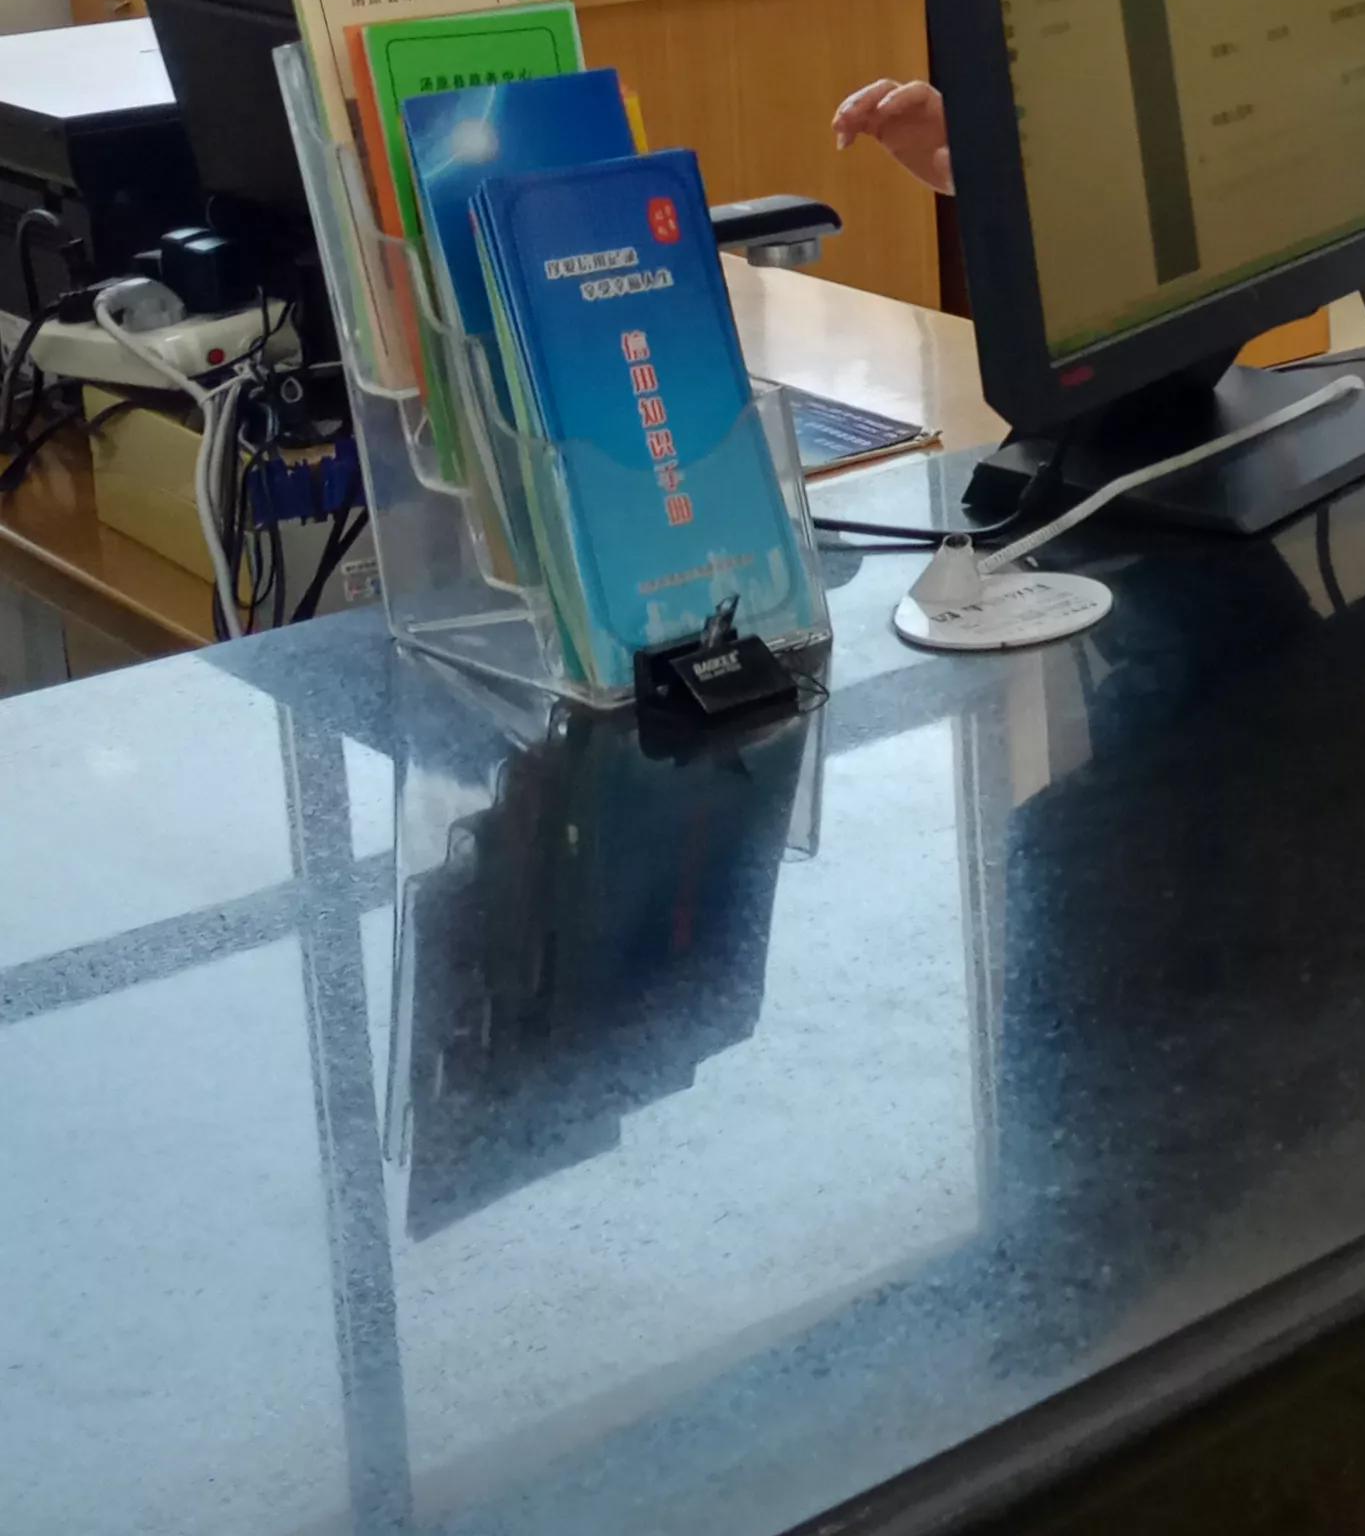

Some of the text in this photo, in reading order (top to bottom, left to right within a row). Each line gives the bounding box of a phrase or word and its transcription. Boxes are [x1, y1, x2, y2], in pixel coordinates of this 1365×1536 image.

[620, 329, 694, 527] 信用知识手册
